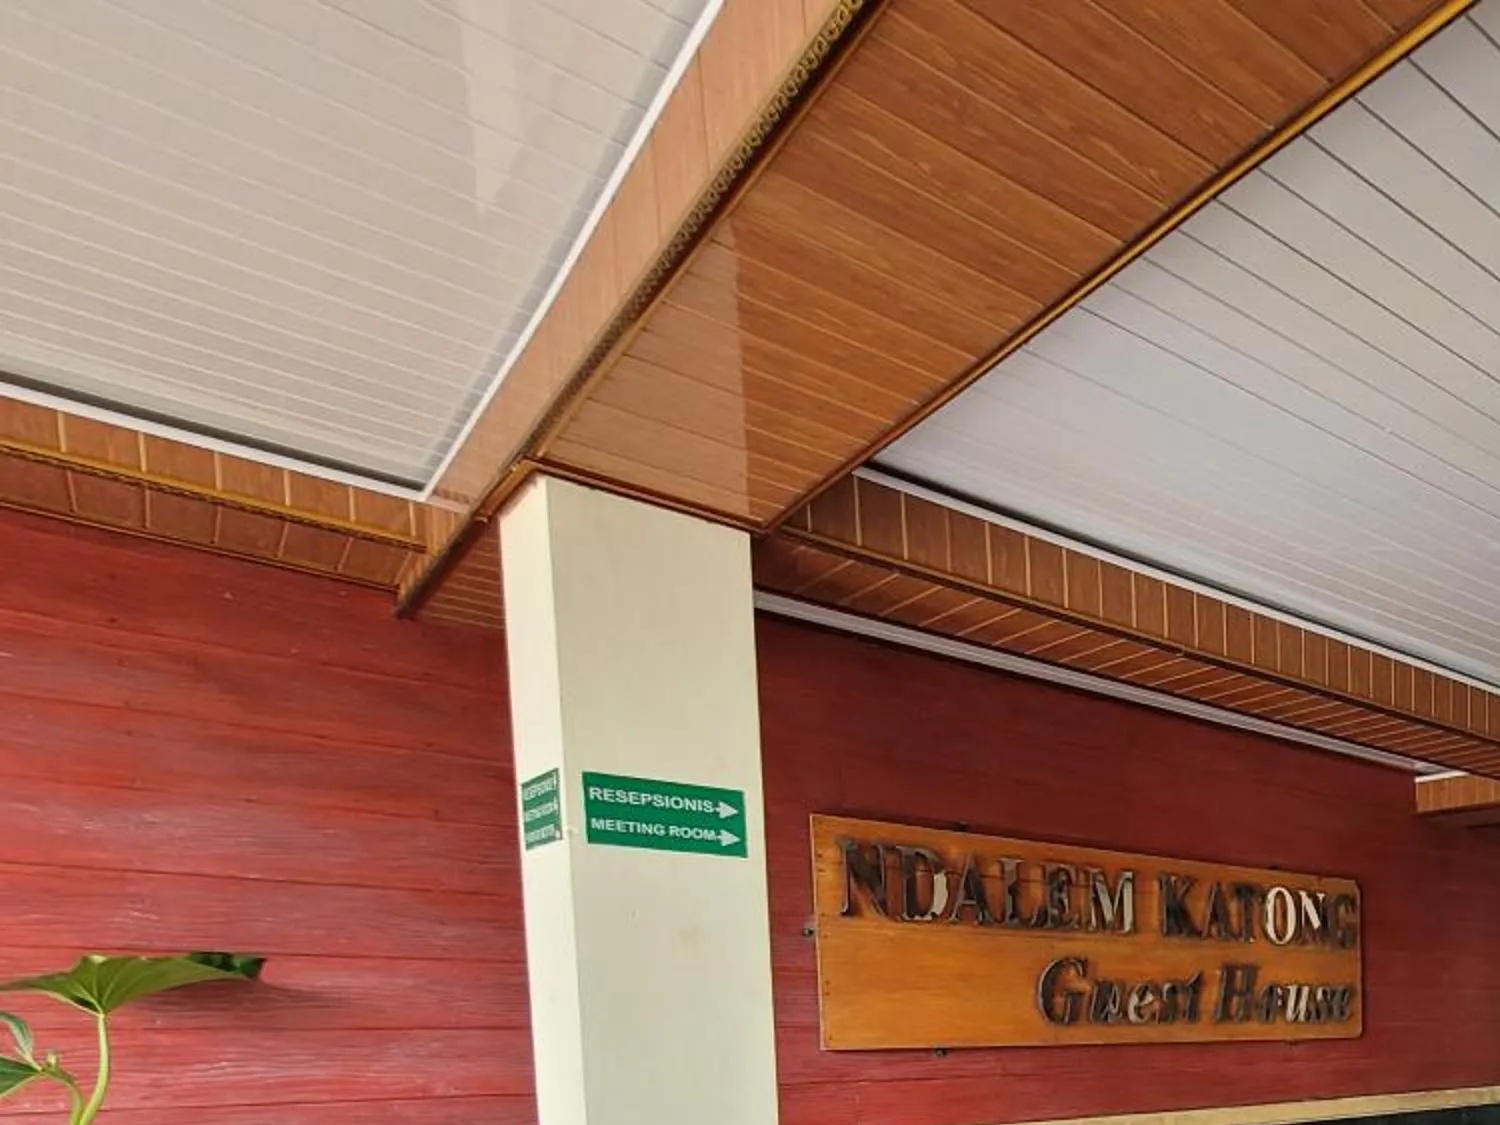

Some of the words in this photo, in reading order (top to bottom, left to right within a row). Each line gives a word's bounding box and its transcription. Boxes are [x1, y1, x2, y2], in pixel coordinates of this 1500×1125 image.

[589, 785, 716, 813] RESEPSIONIS
[591, 817, 665, 836] MEETING
[668, 824, 716, 841] ROOM
[840, 838, 1135, 934] NDALEM
[1158, 873, 1356, 947] KATONG
[1037, 957, 1204, 1026] Guest
[1213, 963, 1352, 1026] House
